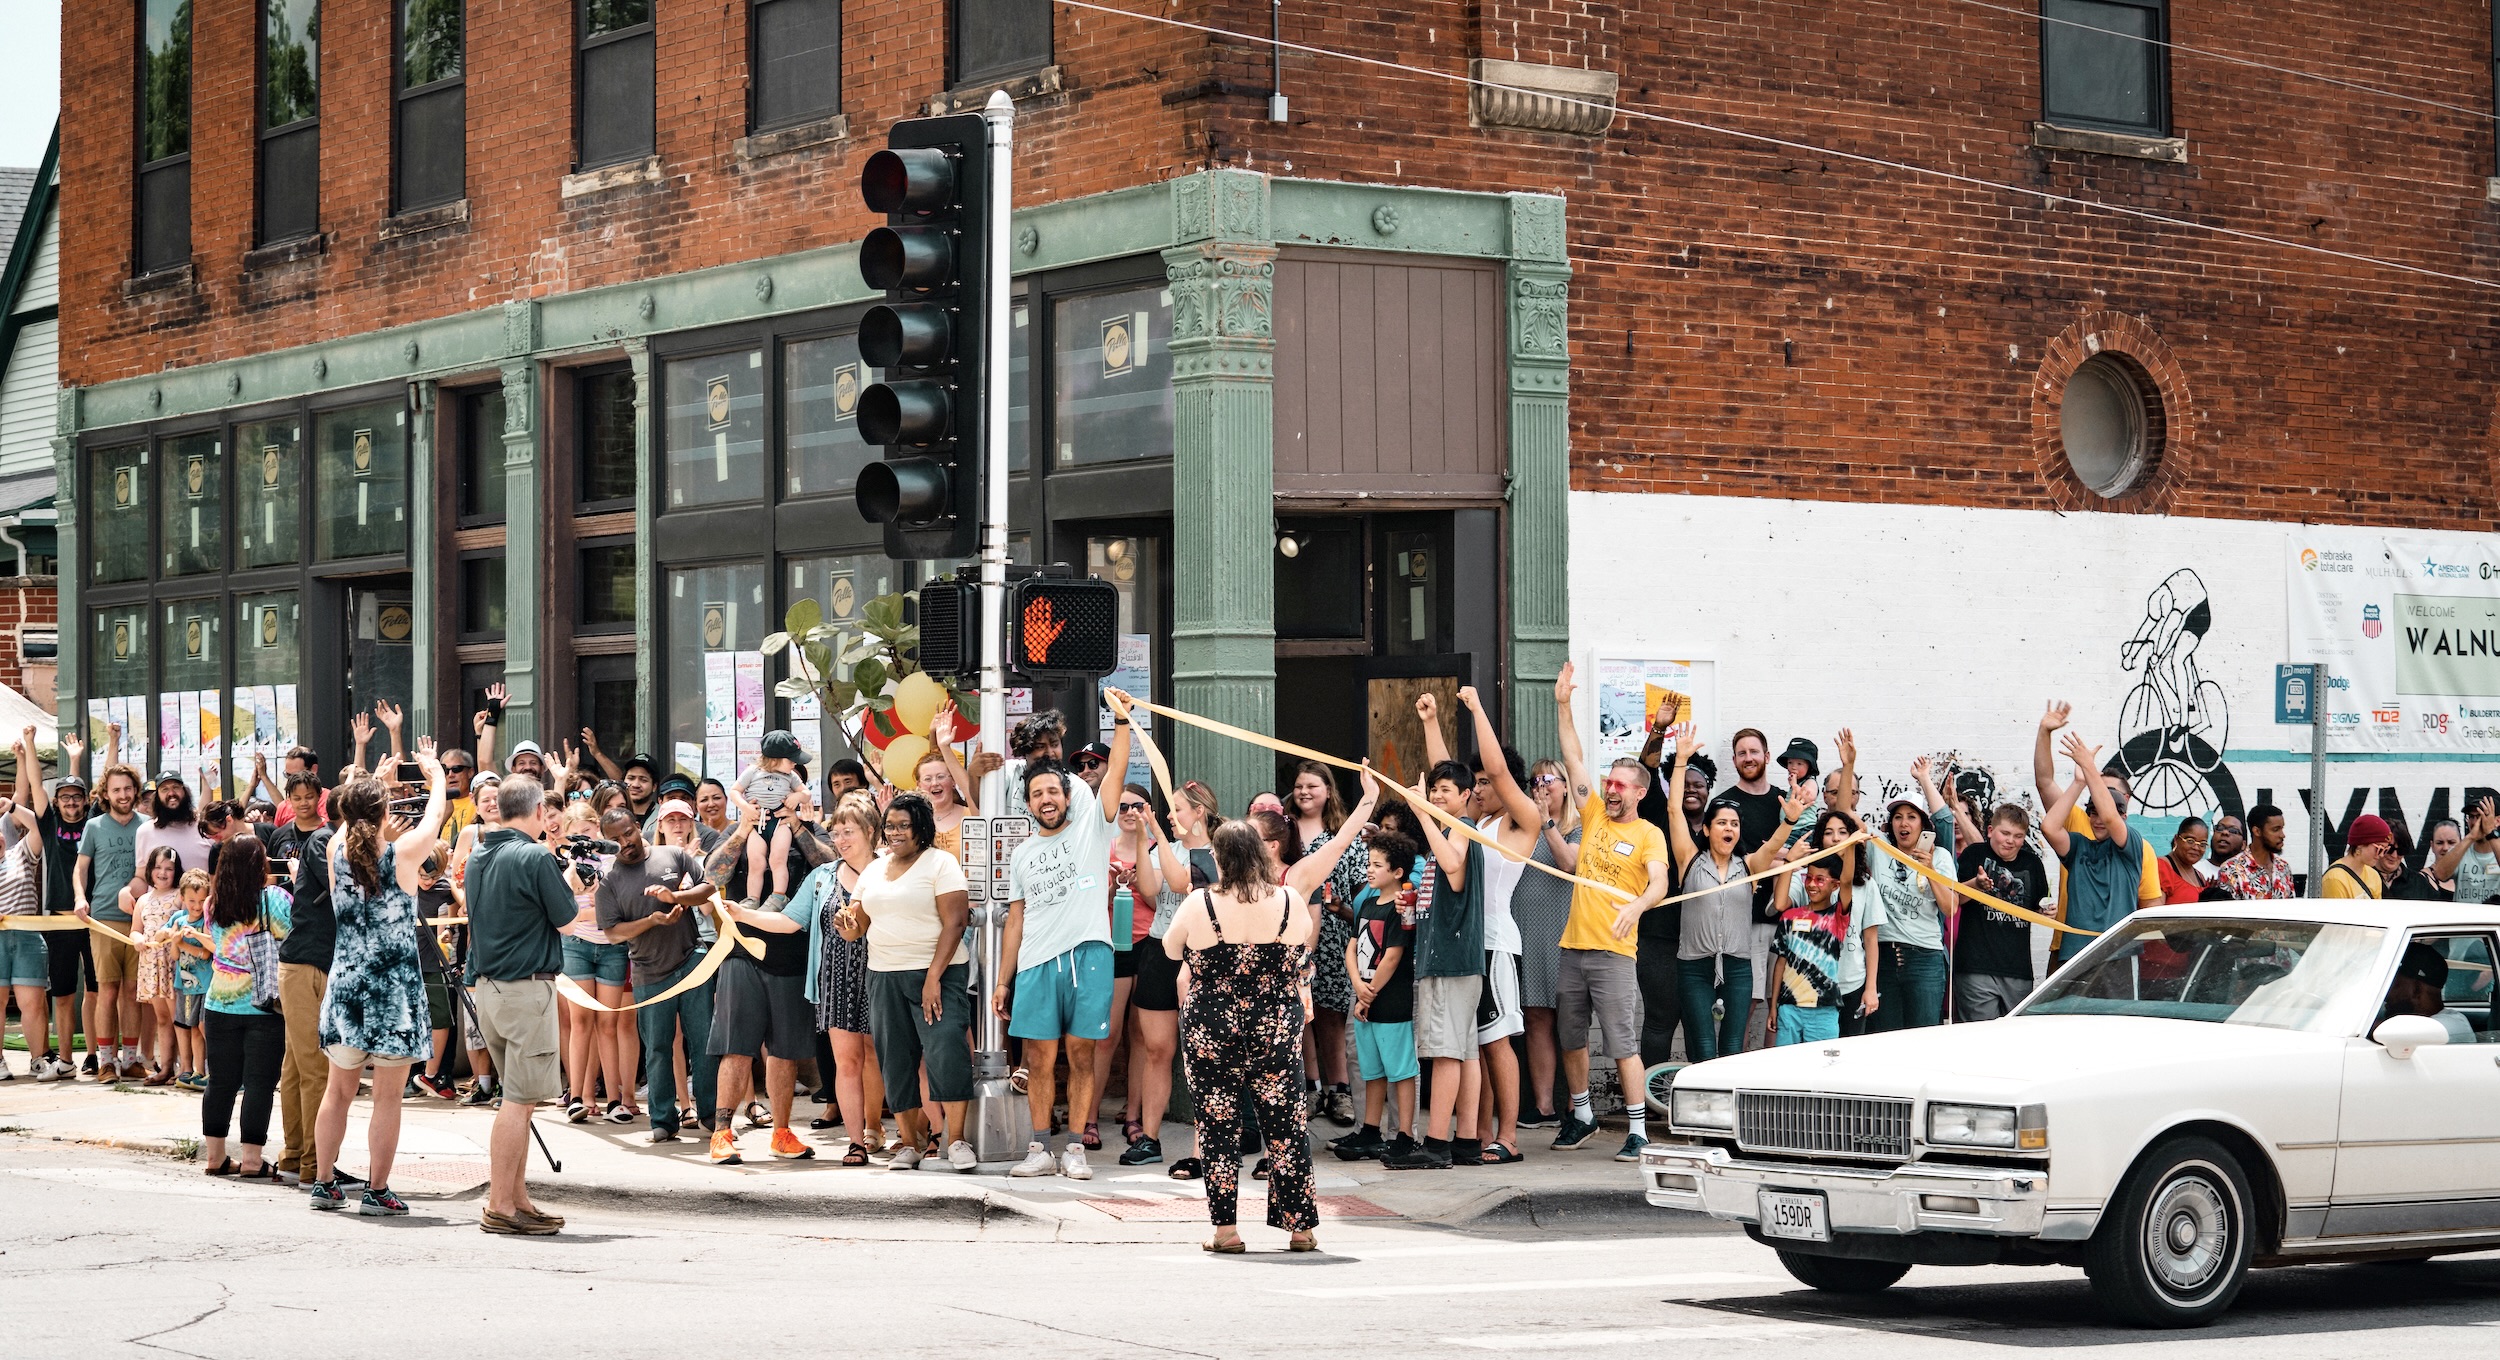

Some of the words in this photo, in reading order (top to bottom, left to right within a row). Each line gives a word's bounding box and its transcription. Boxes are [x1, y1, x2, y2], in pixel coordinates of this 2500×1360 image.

[2320, 550, 2352, 561] nebraska
[2320, 563, 2336, 572] total
[2337, 564, 2354, 573] care
[2438, 565, 2470, 573] AMERICAN
[2406, 605, 2456, 617] WELCOME
[381, 614, 409, 630] Pella
[2326, 713, 2360, 723] TSIGNS
[2372, 710, 2400, 723] TD2
[109, 836, 134, 847] LOV
[1595, 828, 1617, 848] LOV
[1030, 840, 1071, 869] LOVE
[1853, 1135, 1902, 1146] CHEVROLET
[1779, 1197, 1803, 1205] NEBRASKA
[1774, 1204, 1812, 1228] 159DR
